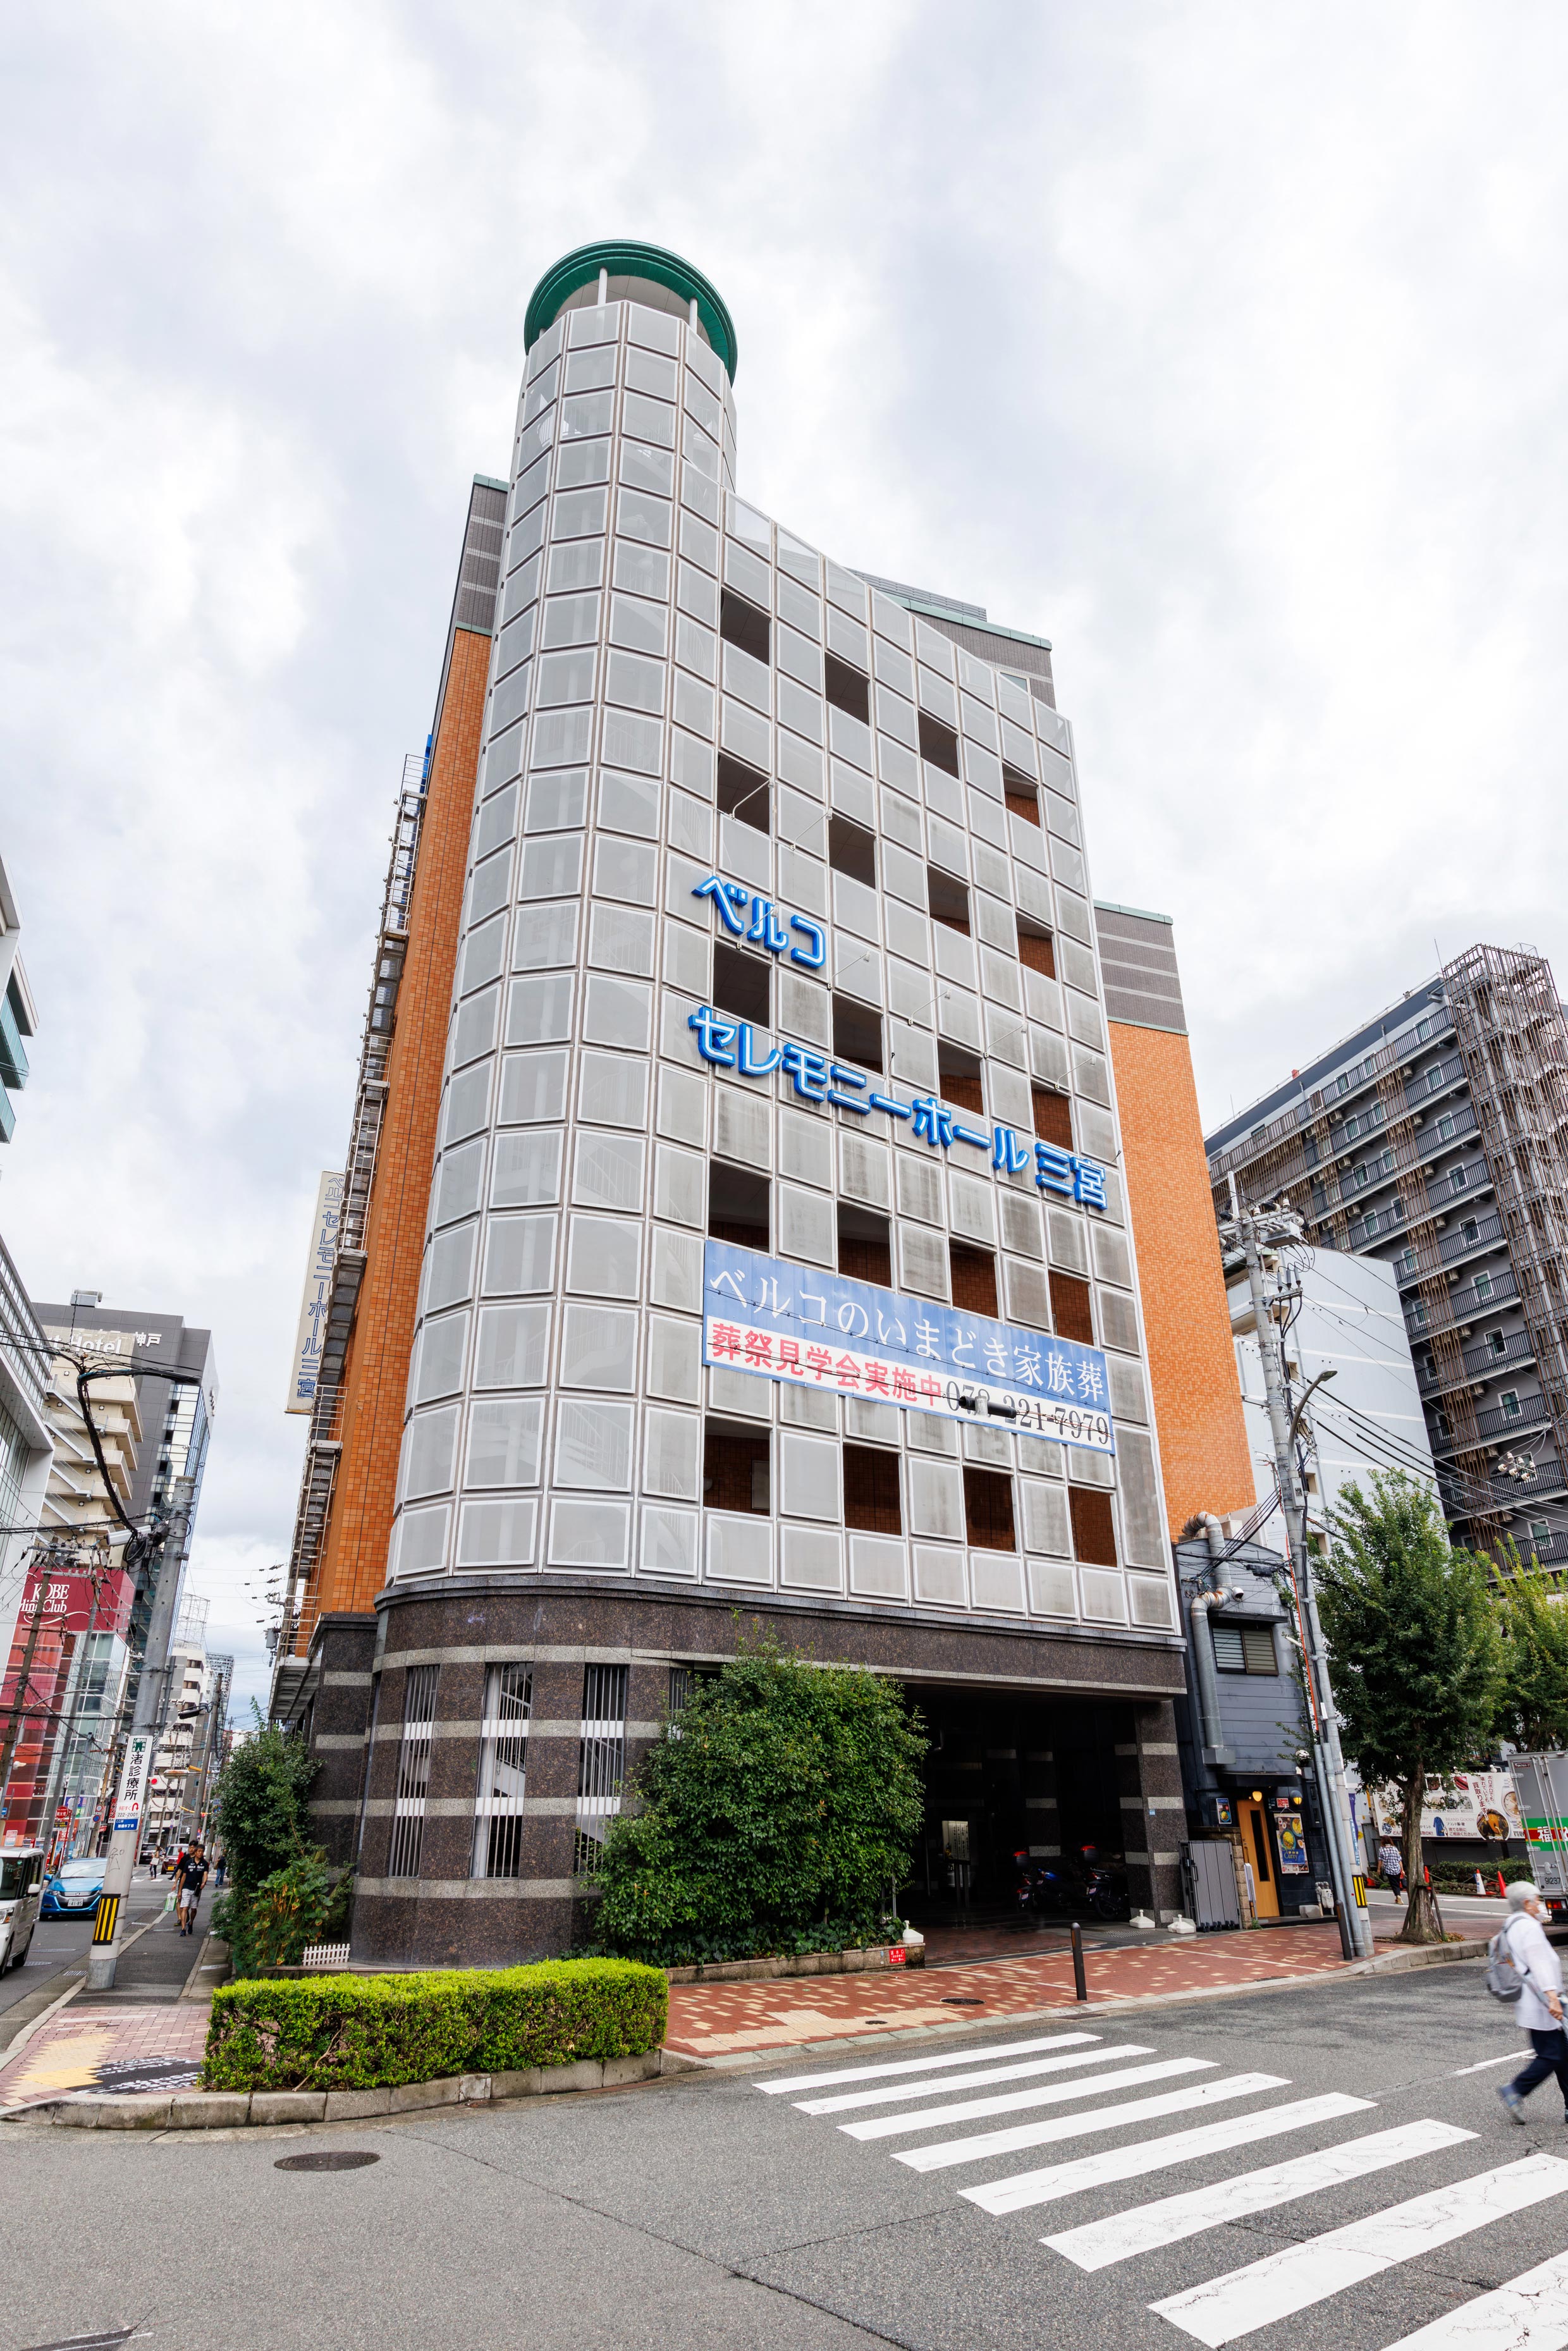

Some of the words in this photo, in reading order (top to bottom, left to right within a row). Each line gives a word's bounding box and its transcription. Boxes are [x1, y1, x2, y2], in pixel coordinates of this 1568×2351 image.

[691, 876, 826, 969] ベルコ
[689, 1006, 1108, 1210] セレモニーホール三宮
[70, 1334, 122, 1355] Hotel
[710, 1268, 1105, 1403] ベルコのいまどき家族葬
[712, 1323, 942, 1407] 葬祭見学会実施中
[30, 1583, 70, 1602] KOBE
[42, 1599, 67, 1613] Club
[124, 1753, 144, 1801] 渚診療所
[1545, 1877, 1561, 1885] 91237
